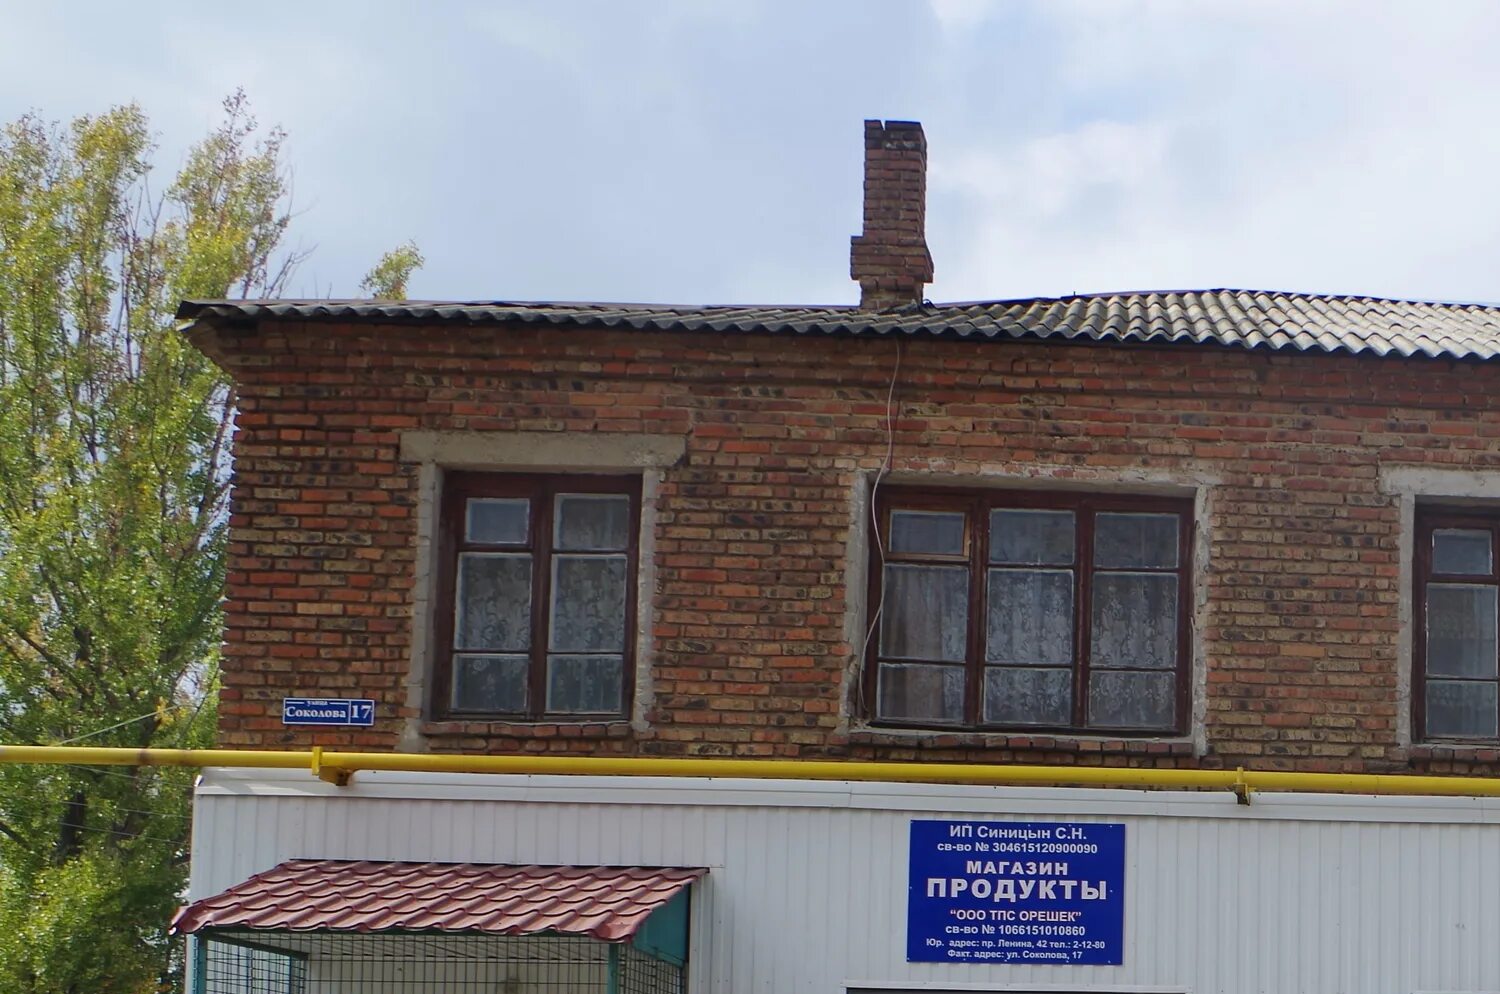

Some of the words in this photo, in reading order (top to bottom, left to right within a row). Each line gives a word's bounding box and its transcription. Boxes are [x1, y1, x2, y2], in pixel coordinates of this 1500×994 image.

[286, 706, 346, 718] Соколова
[352, 705, 372, 719] 17
[950, 825, 973, 838] ИП
[977, 826, 1051, 840] Синицын
[1055, 827, 1087, 840] С.Н.
[937, 842, 972, 852] св-во
[975, 842, 990, 852] №
[992, 842, 1098, 854] 304615120900090
[966, 860, 1068, 875] МАГАЗИН
[927, 878, 1107, 903] ПРОДУКТЫ
[989, 910, 1016, 921] ТПС
[945, 925, 979, 934] св-во
[981, 924, 996, 934] №
[998, 925, 1086, 936] 1066151010860
[926, 938, 945, 948] Юр.
[949, 940, 980, 948] адрес:
[981, 940, 996, 949] пр.
[998, 939, 1035, 949] Ленина,
[1036, 940, 1048, 948] 42
[947, 949, 973, 957] Факт.
[974, 950, 1005, 959] адрес:
[1006, 951, 1021, 960] ул.
[1022, 950, 1070, 960] Соколова,
[1072, 951, 1083, 959] 17
